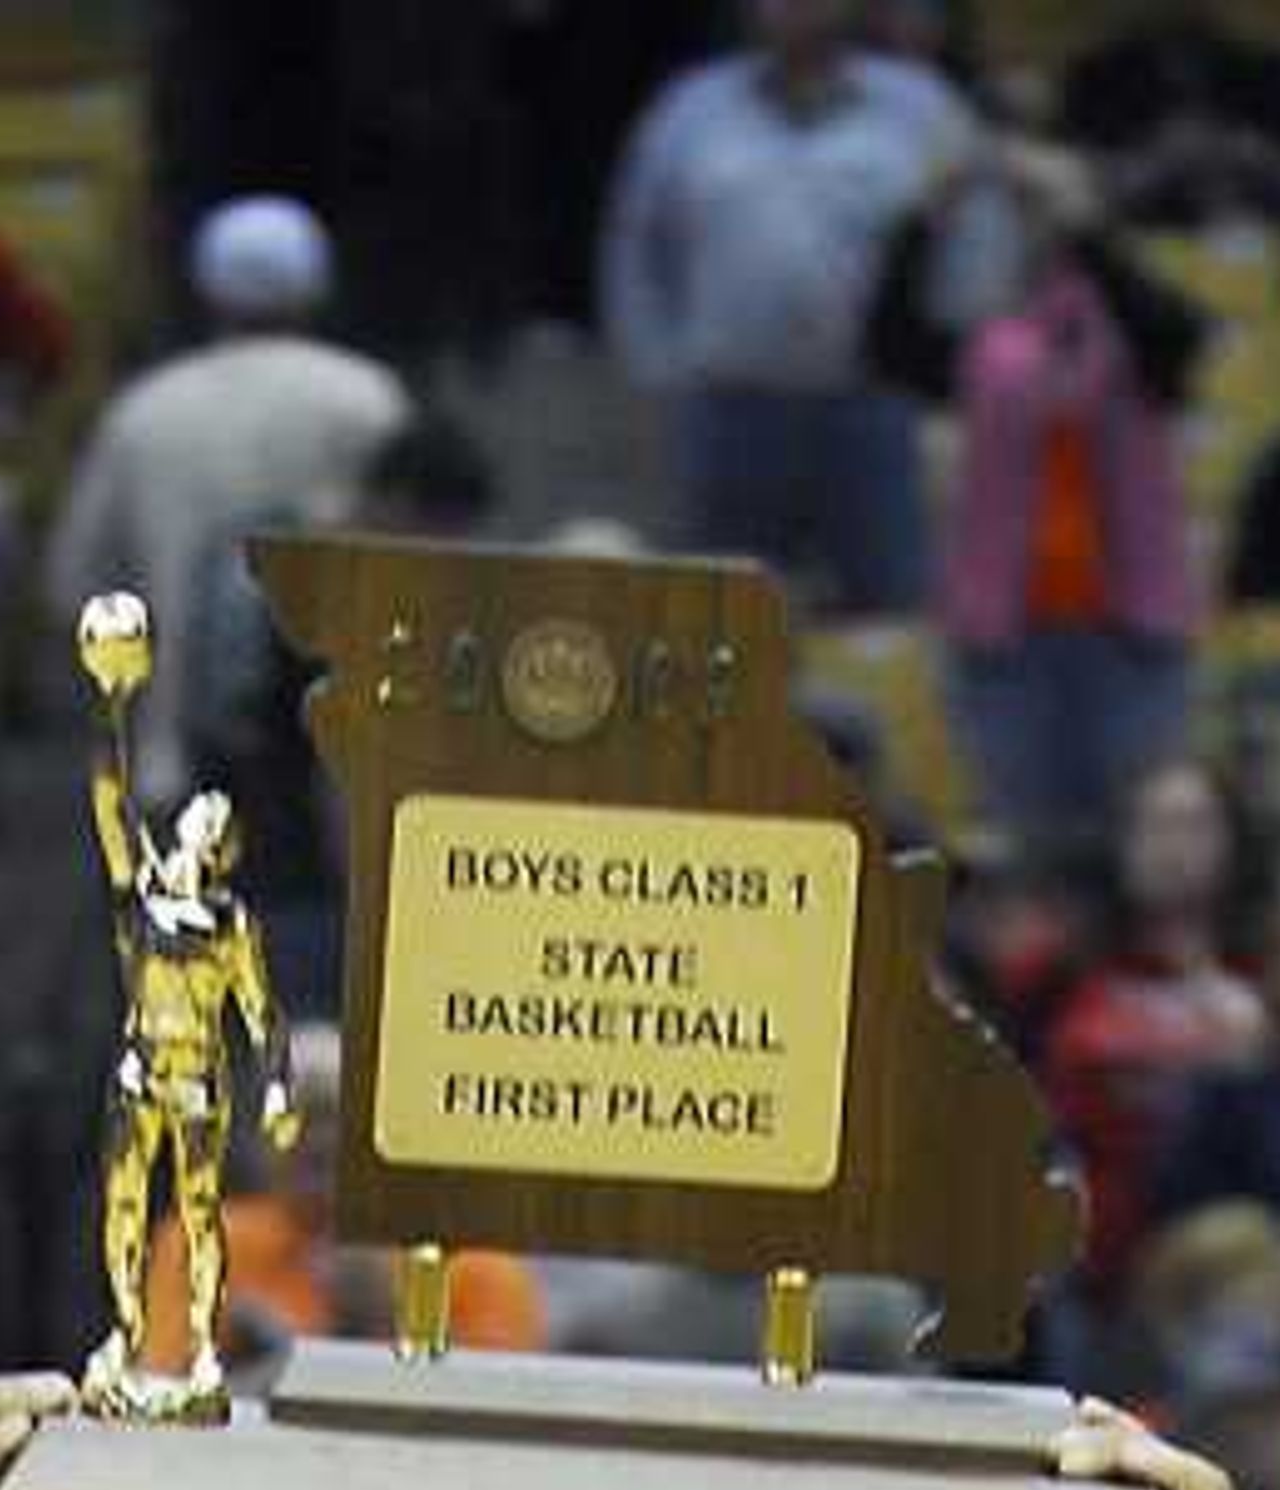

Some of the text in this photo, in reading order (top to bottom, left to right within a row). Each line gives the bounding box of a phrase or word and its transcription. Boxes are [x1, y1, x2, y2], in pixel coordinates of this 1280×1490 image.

[446, 846, 809, 912] BOYS CLASS 1
[541, 936, 700, 986] STATE
[444, 992, 786, 1055] BASKETBALL
[442, 1071, 776, 1135] FIRST PLACE
